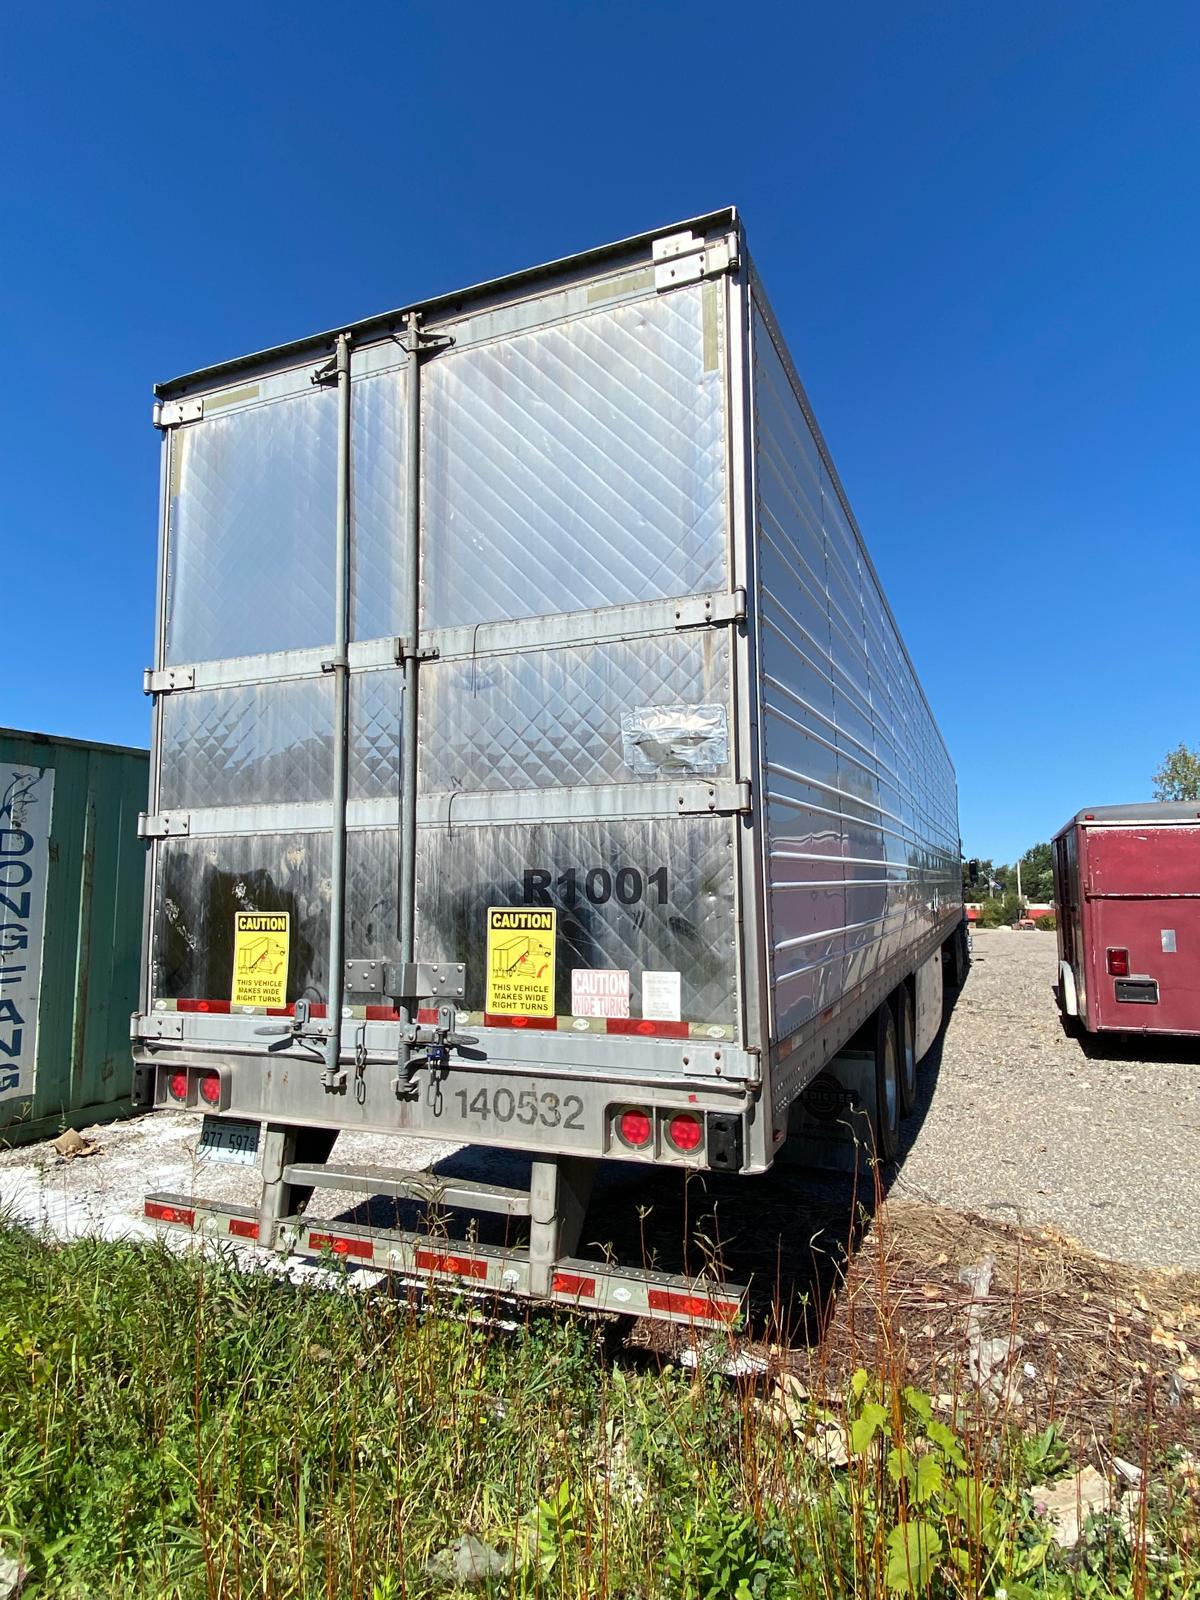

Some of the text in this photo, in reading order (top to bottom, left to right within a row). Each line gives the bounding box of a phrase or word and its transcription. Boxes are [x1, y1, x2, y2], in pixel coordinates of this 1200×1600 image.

[523, 866, 668, 905] R1001
[239, 917, 286, 930] CAUTION
[492, 913, 551, 928] CAUTION
[492, 983, 549, 993] THIS VEHICLE
[572, 972, 629, 995] CAUTION
[258, 995, 282, 1003] TURNS
[494, 992, 546, 1002] MAKES WIDE
[492, 1001, 549, 1011] RIGHT TURNS
[573, 996, 628, 1016] WIDE TURNS
[454, 1087, 585, 1131] 140532
[203, 1131, 223, 1152] 977
[229, 1133, 249, 1155] 597
